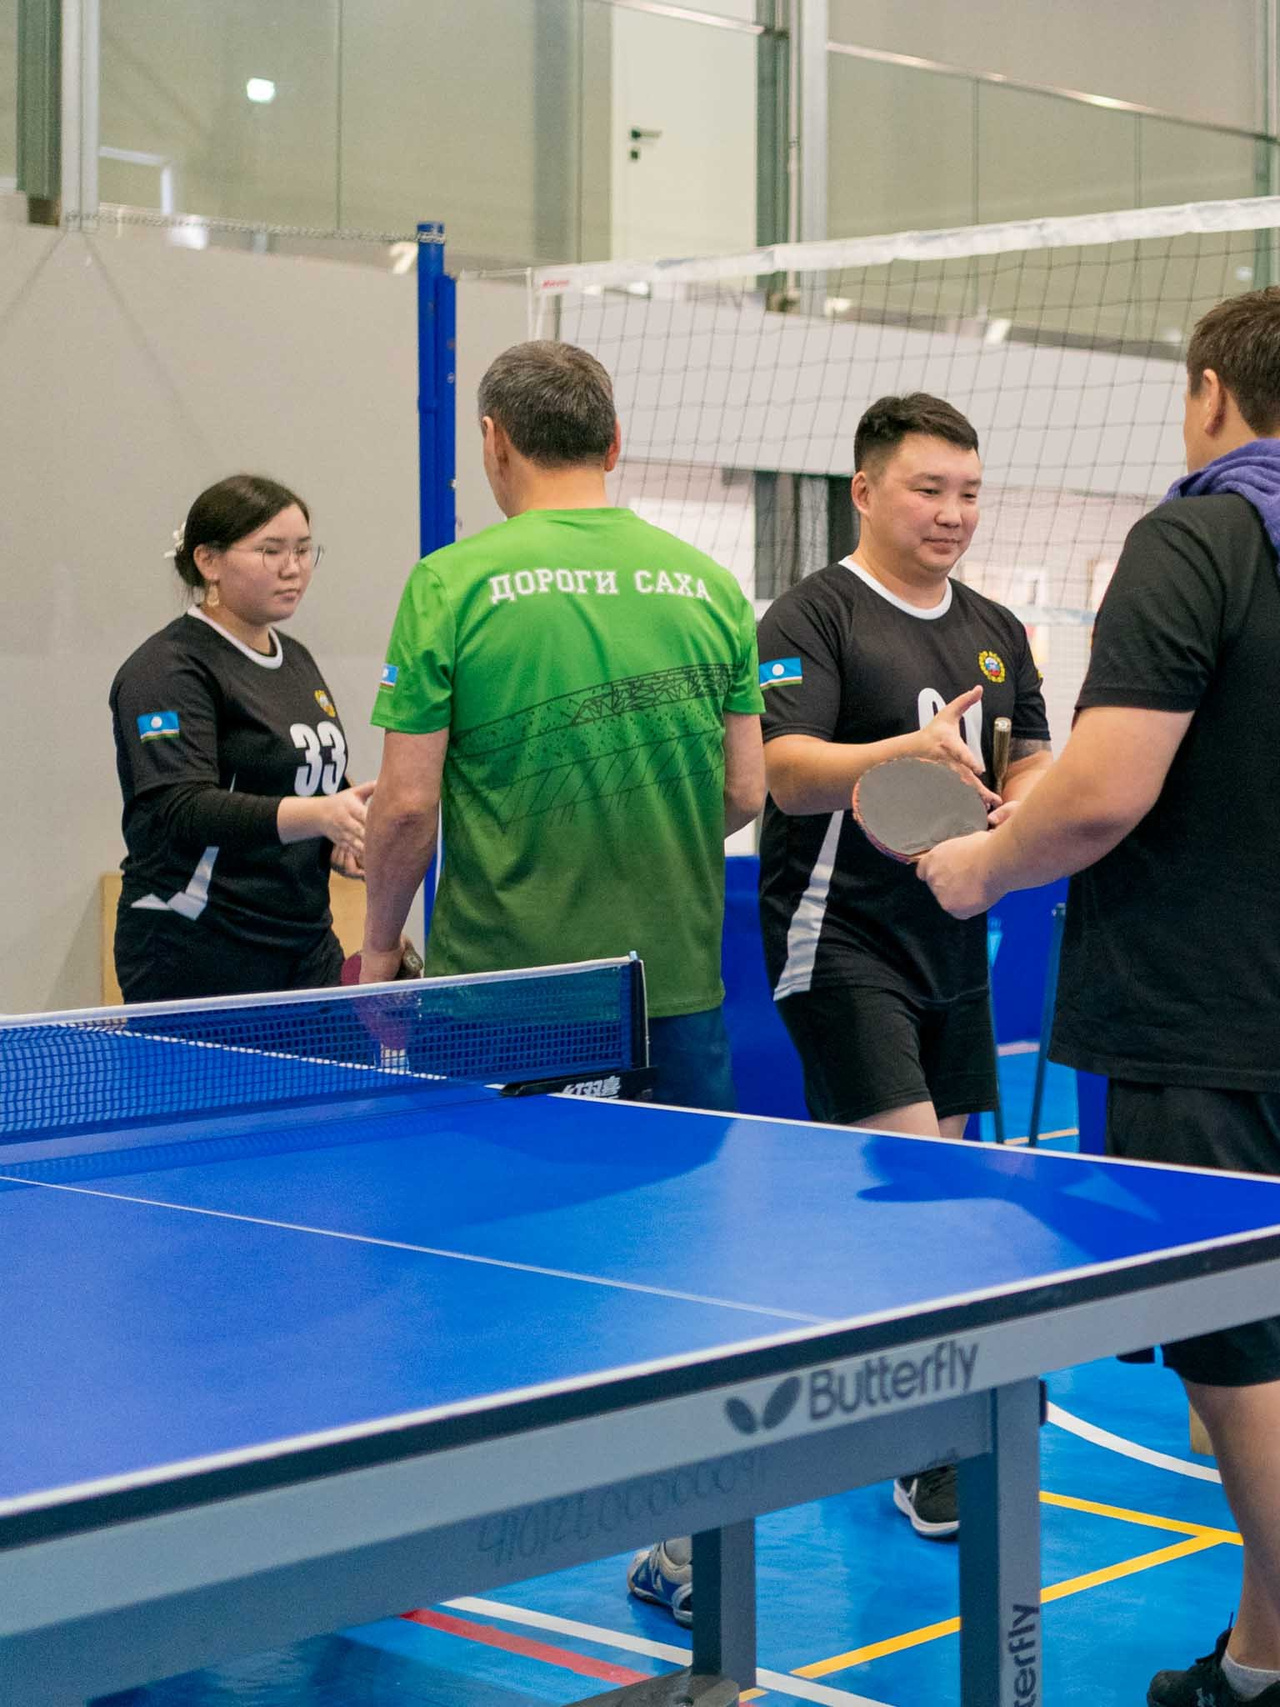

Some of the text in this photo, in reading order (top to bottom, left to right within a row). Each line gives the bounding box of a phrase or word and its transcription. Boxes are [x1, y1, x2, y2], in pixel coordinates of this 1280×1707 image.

[489, 568, 712, 604] ДОРОГИ САХА
[290, 721, 347, 797] 33
[810, 1339, 979, 1420] Butterfly
